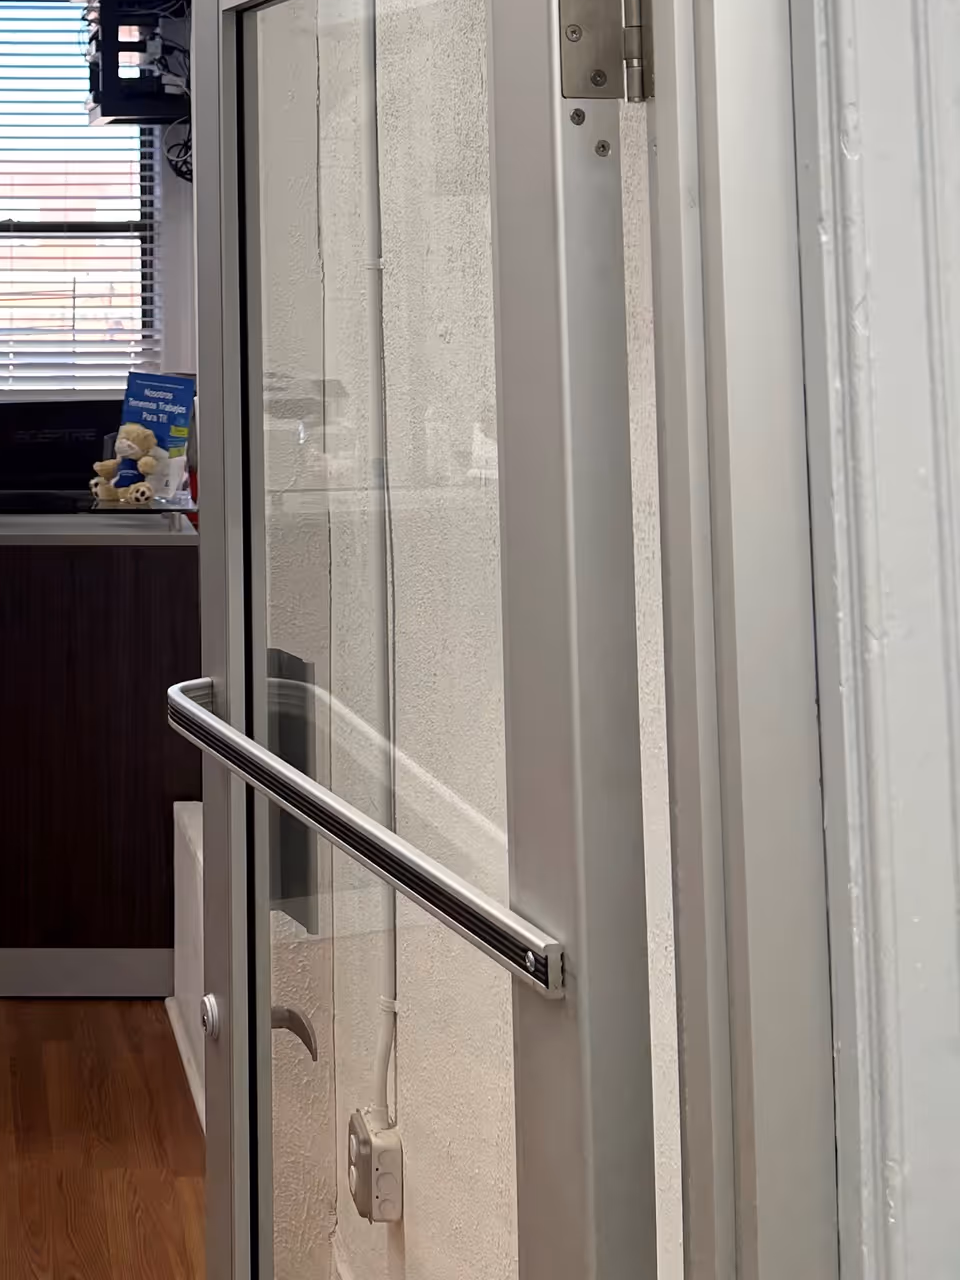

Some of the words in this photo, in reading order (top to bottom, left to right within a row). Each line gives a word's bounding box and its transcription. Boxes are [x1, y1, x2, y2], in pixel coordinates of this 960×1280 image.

[143, 387, 174, 400] Nosotros
[128, 397, 158, 410] Tenemos
[158, 401, 187, 415] Trabajos
[142, 411, 158, 422] Para
